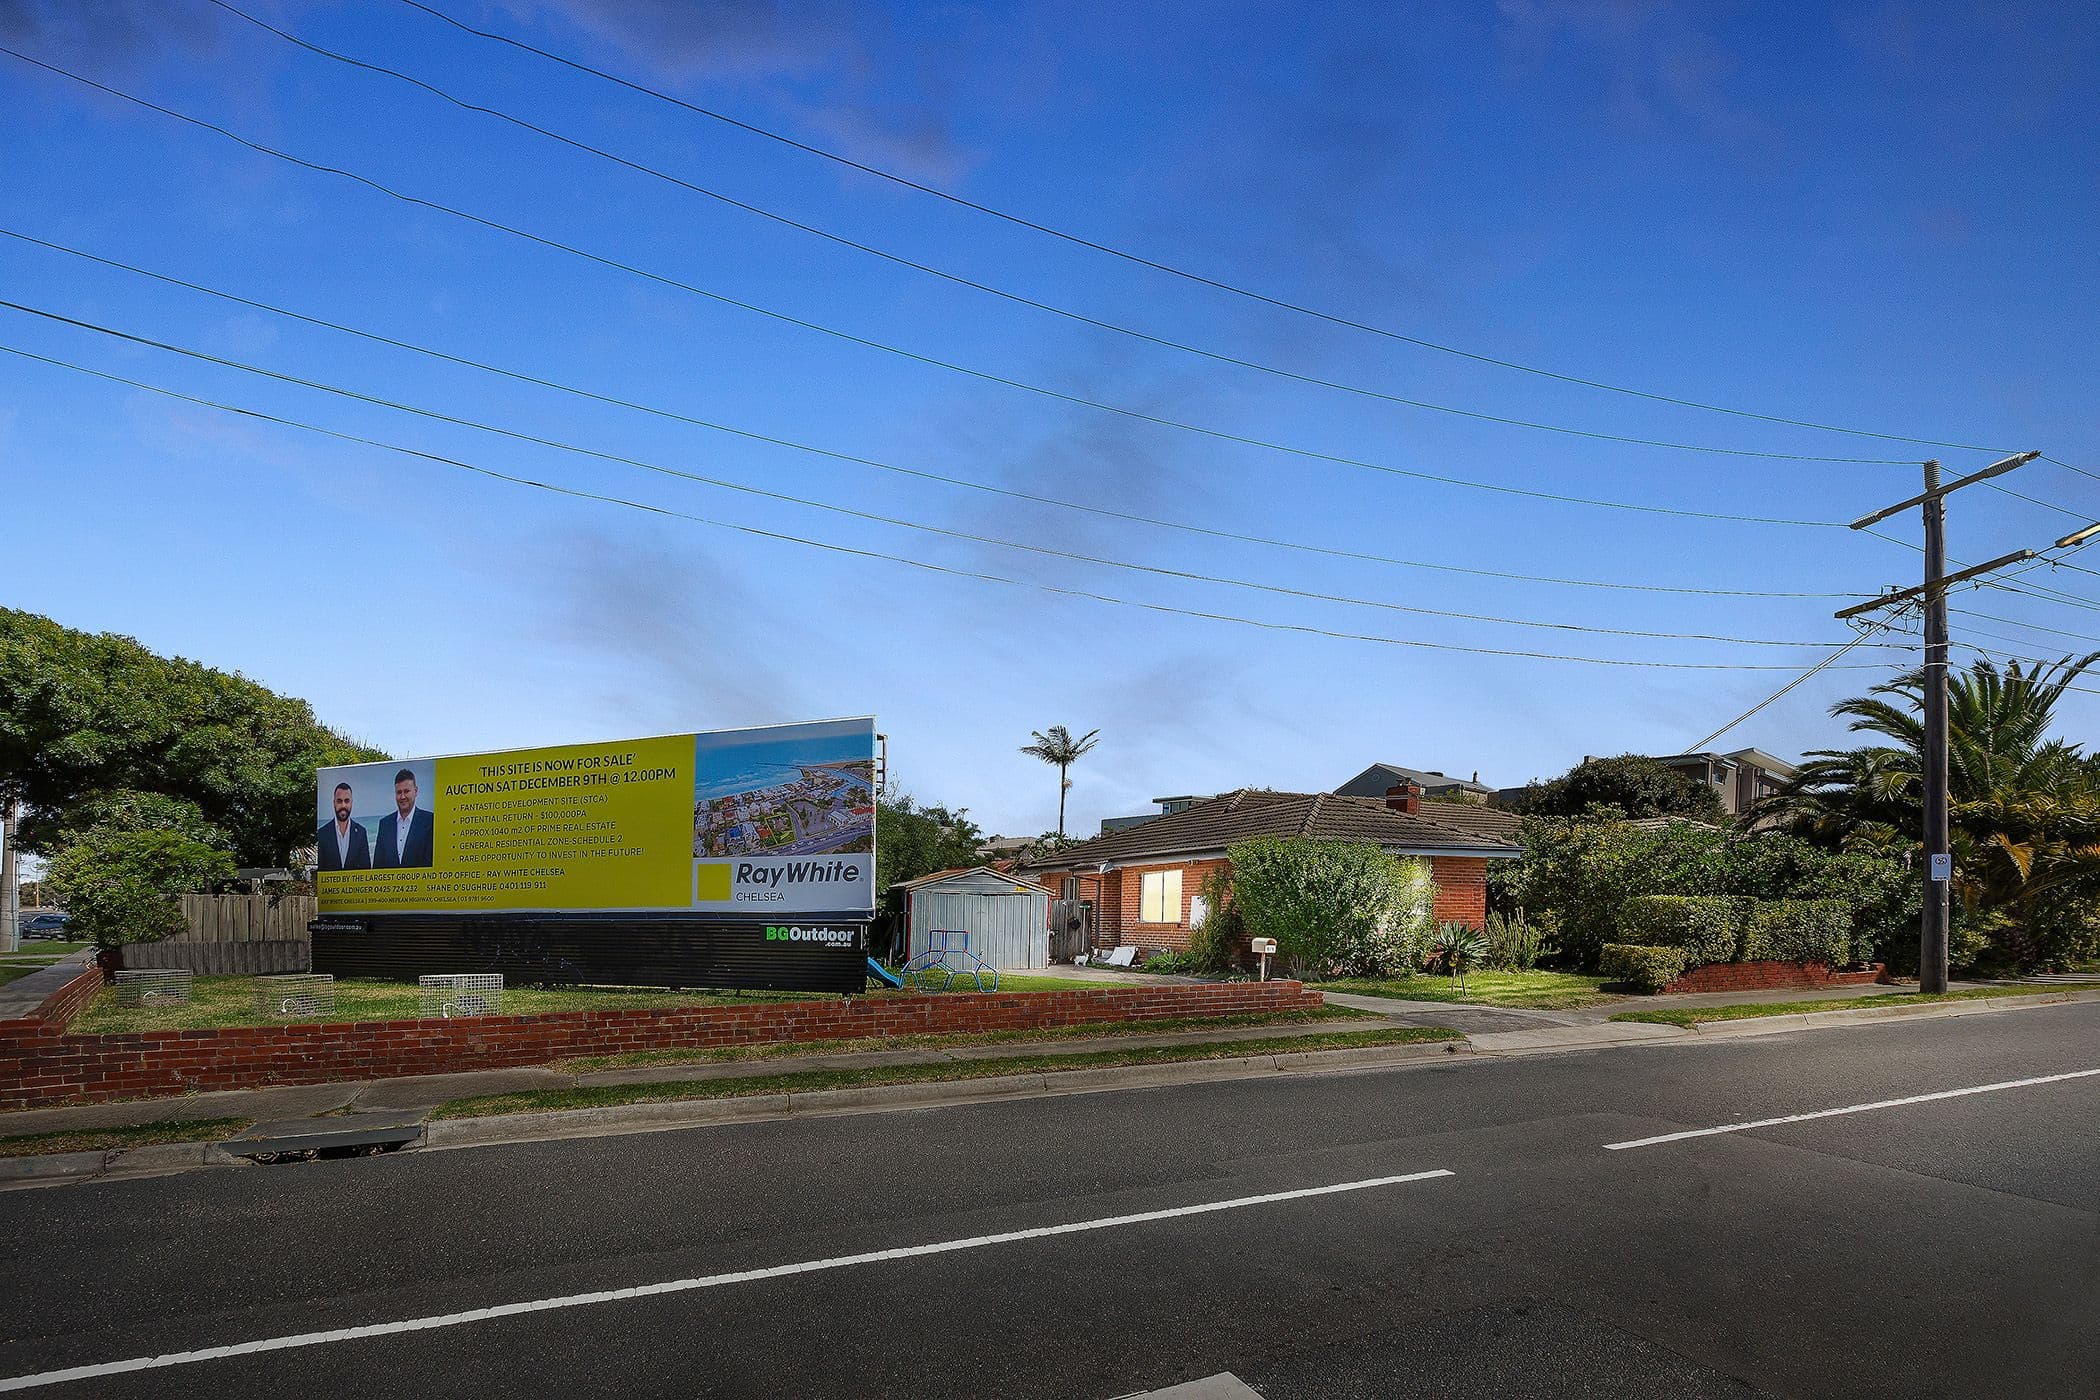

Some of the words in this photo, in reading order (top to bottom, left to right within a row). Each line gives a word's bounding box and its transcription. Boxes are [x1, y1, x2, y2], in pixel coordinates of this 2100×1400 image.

[508, 763, 530, 775] SITE
[533, 761, 542, 772] IS
[545, 760, 574, 771] NOW
[577, 757, 601, 769] FOR
[446, 783, 494, 795] AUCTION
[496, 780, 518, 792] SAT
[520, 776, 580, 790] DECEMBER
[583, 774, 607, 785] 9TH
[610, 773, 620, 785] @
[624, 768, 675, 783] 12.00PM
[460, 802, 500, 812] FANTASTIC
[502, 798, 559, 809] DEVELOPMENT
[561, 797, 578, 806] SITE
[580, 794, 608, 805] (STCA)
[460, 816, 500, 825] POTENTIAL
[503, 813, 533, 822] RETURN
[541, 810, 587, 820] $100,000PA
[460, 828, 489, 837] APPROX
[491, 827, 508, 836] 1040
[511, 827, 522, 835] m2
[525, 825, 535, 834] OF
[537, 824, 561, 833] PRIME
[563, 823, 584, 832] REAL
[587, 821, 616, 831] ESTATE
[460, 842, 494, 850] GENERAL
[496, 839, 545, 849] RESIDENTIAL
[548, 835, 615, 846] ZONE-SCHEDULE
[618, 834, 623, 843] 2
[460, 854, 479, 863] RARE
[481, 851, 535, 862] OPPORTUNITY
[537, 851, 547, 859] TO
[550, 850, 577, 859] INVEST
[580, 850, 588, 858] IN
[591, 849, 606, 857] THE
[608, 847, 644, 857] FUTURE!
[321, 875, 341, 884] LISTED
[342, 875, 351, 883] BY
[352, 874, 366, 882] THE
[367, 873, 395, 882] LARGEST
[397, 872, 420, 881] GROUP
[422, 872, 437, 880] AND
[439, 871, 453, 879] TOP
[454, 870, 480, 879] OFFICE
[487, 870, 501, 878] RAY
[503, 868, 528, 878] WHITE
[530, 868, 565, 876] CHELSEA
[321, 887, 340, 895] JAMES
[341, 886, 372, 894] ALDINGER
[426, 884, 451, 892] SHANE
[499, 882, 518, 890] 0401
[519, 881, 532, 889] 119
[534, 881, 547, 889] 911
[736, 892, 785, 901] CHELSEA
[766, 927, 854, 941] BGOutdoor
